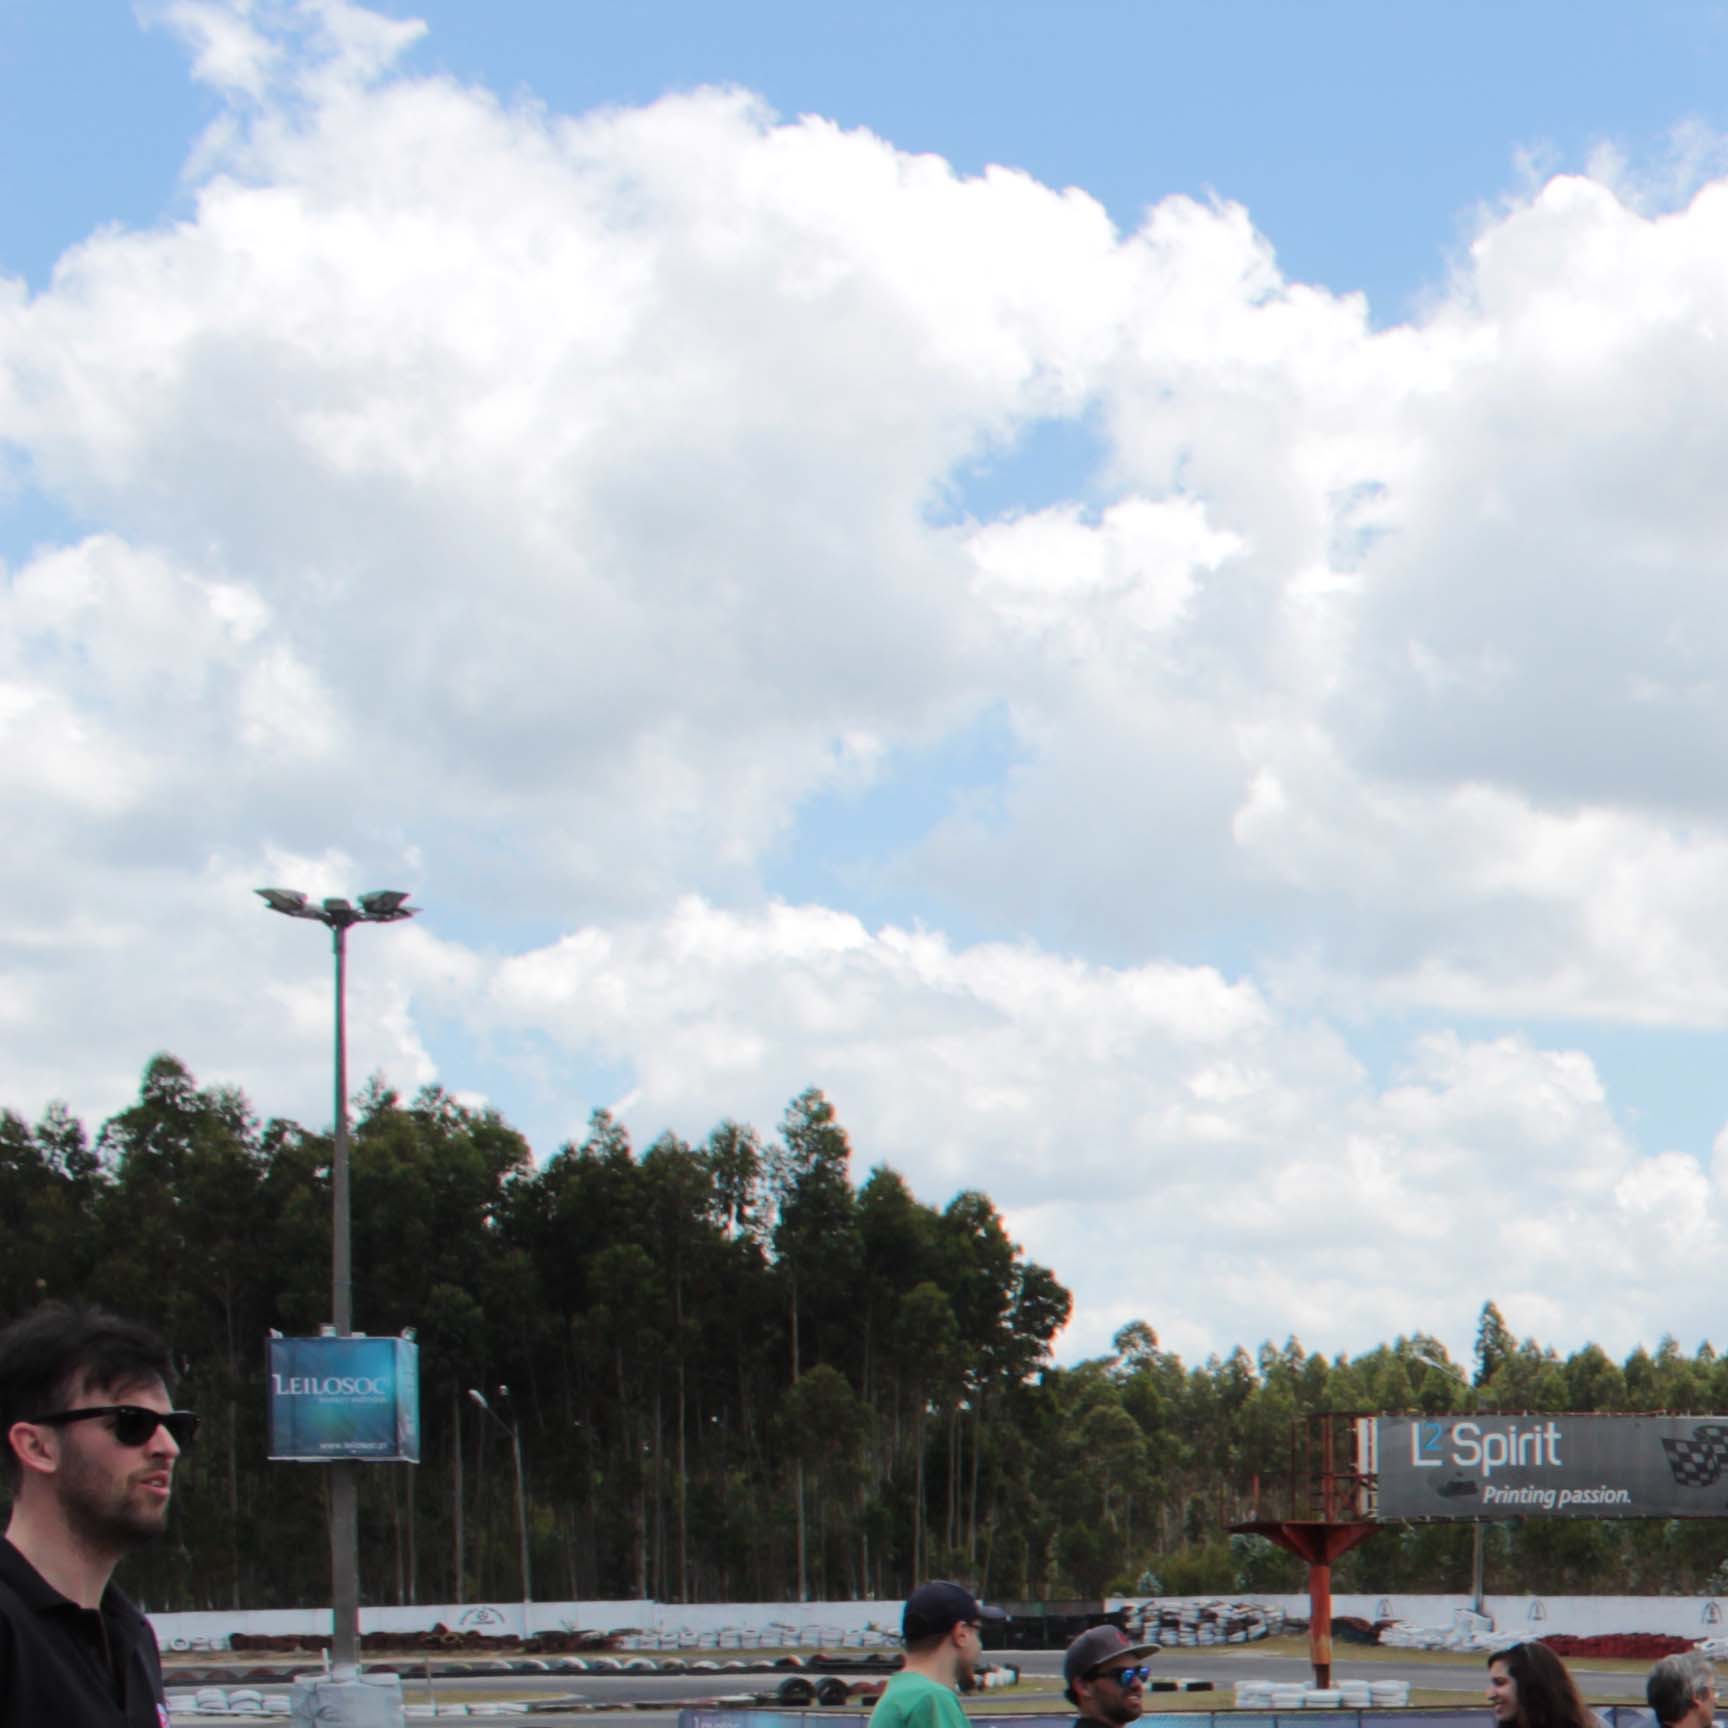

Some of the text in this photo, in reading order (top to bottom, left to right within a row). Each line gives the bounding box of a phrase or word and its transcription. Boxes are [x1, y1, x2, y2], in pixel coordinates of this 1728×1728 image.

[272, 1374, 386, 1395] LEILOSOC
[1451, 1422, 1562, 1477] Spirit
[1483, 1484, 1632, 1510] Printing passion.
